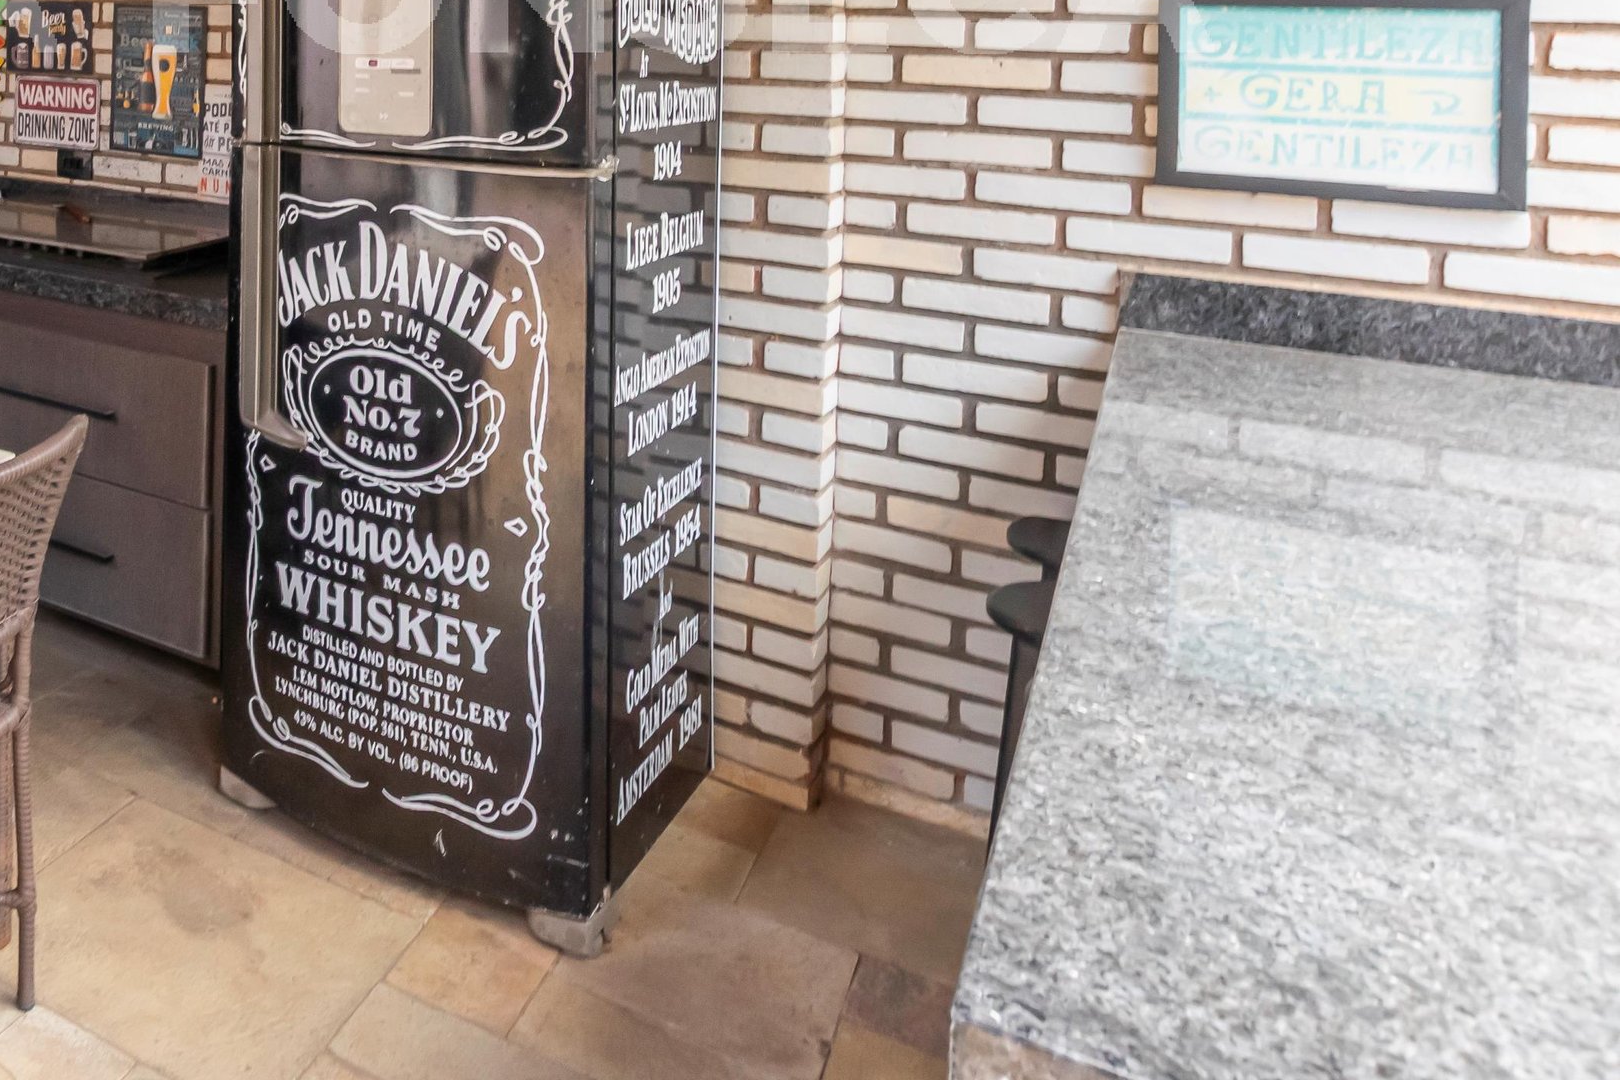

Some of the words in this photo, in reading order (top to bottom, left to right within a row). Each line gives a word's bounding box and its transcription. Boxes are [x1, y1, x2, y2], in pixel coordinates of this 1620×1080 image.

[42, 9, 66, 28] Beer
[1191, 17, 1487, 65] GENTILEZA
[20, 83, 95, 110] WARNING
[1240, 72, 1388, 115] GERA
[18, 114, 66, 141] DRINKING
[68, 116, 95, 144] ZONE
[1194, 125, 1472, 171] GENTILEZA
[653, 140, 682, 181] 1904
[279, 240, 356, 328] JACK
[359, 220, 532, 370] DANIEL'S
[652, 266, 681, 314] 1905
[327, 308, 372, 333] OLD
[380, 310, 442, 351] TIME
[349, 365, 413, 404] Old
[671, 381, 697, 430] 1914
[345, 429, 418, 462] BRAND
[341, 488, 416, 523] QUALITY
[287, 474, 491, 592] Tennessee
[674, 503, 701, 557] 1954
[304, 550, 366, 582] SOUR
[382, 574, 461, 610] MASH
[276, 561, 502, 674] WHISKEY
[268, 631, 309, 664] JACK
[313, 649, 382, 692] DANIEL
[387, 675, 510, 732] DISTILLERY
[302, 624, 357, 657] DISTILLED
[359, 647, 384, 668] AND
[387, 655, 443, 688] BOTTLED
[446, 674, 464, 692] BY
[275, 675, 345, 720] LYNCHBURG
[293, 665, 318, 690] LEM
[321, 677, 379, 716] MOTLOW,
[383, 700, 474, 746] PROPRIETOR
[678, 694, 702, 751] 1981
[293, 709, 317, 732] 43%
[320, 720, 344, 744] ALC.
[348, 732, 365, 752] BY
[367, 741, 395, 764] VOL.
[399, 751, 419, 773] (86
[421, 762, 473, 794] PROOF)
